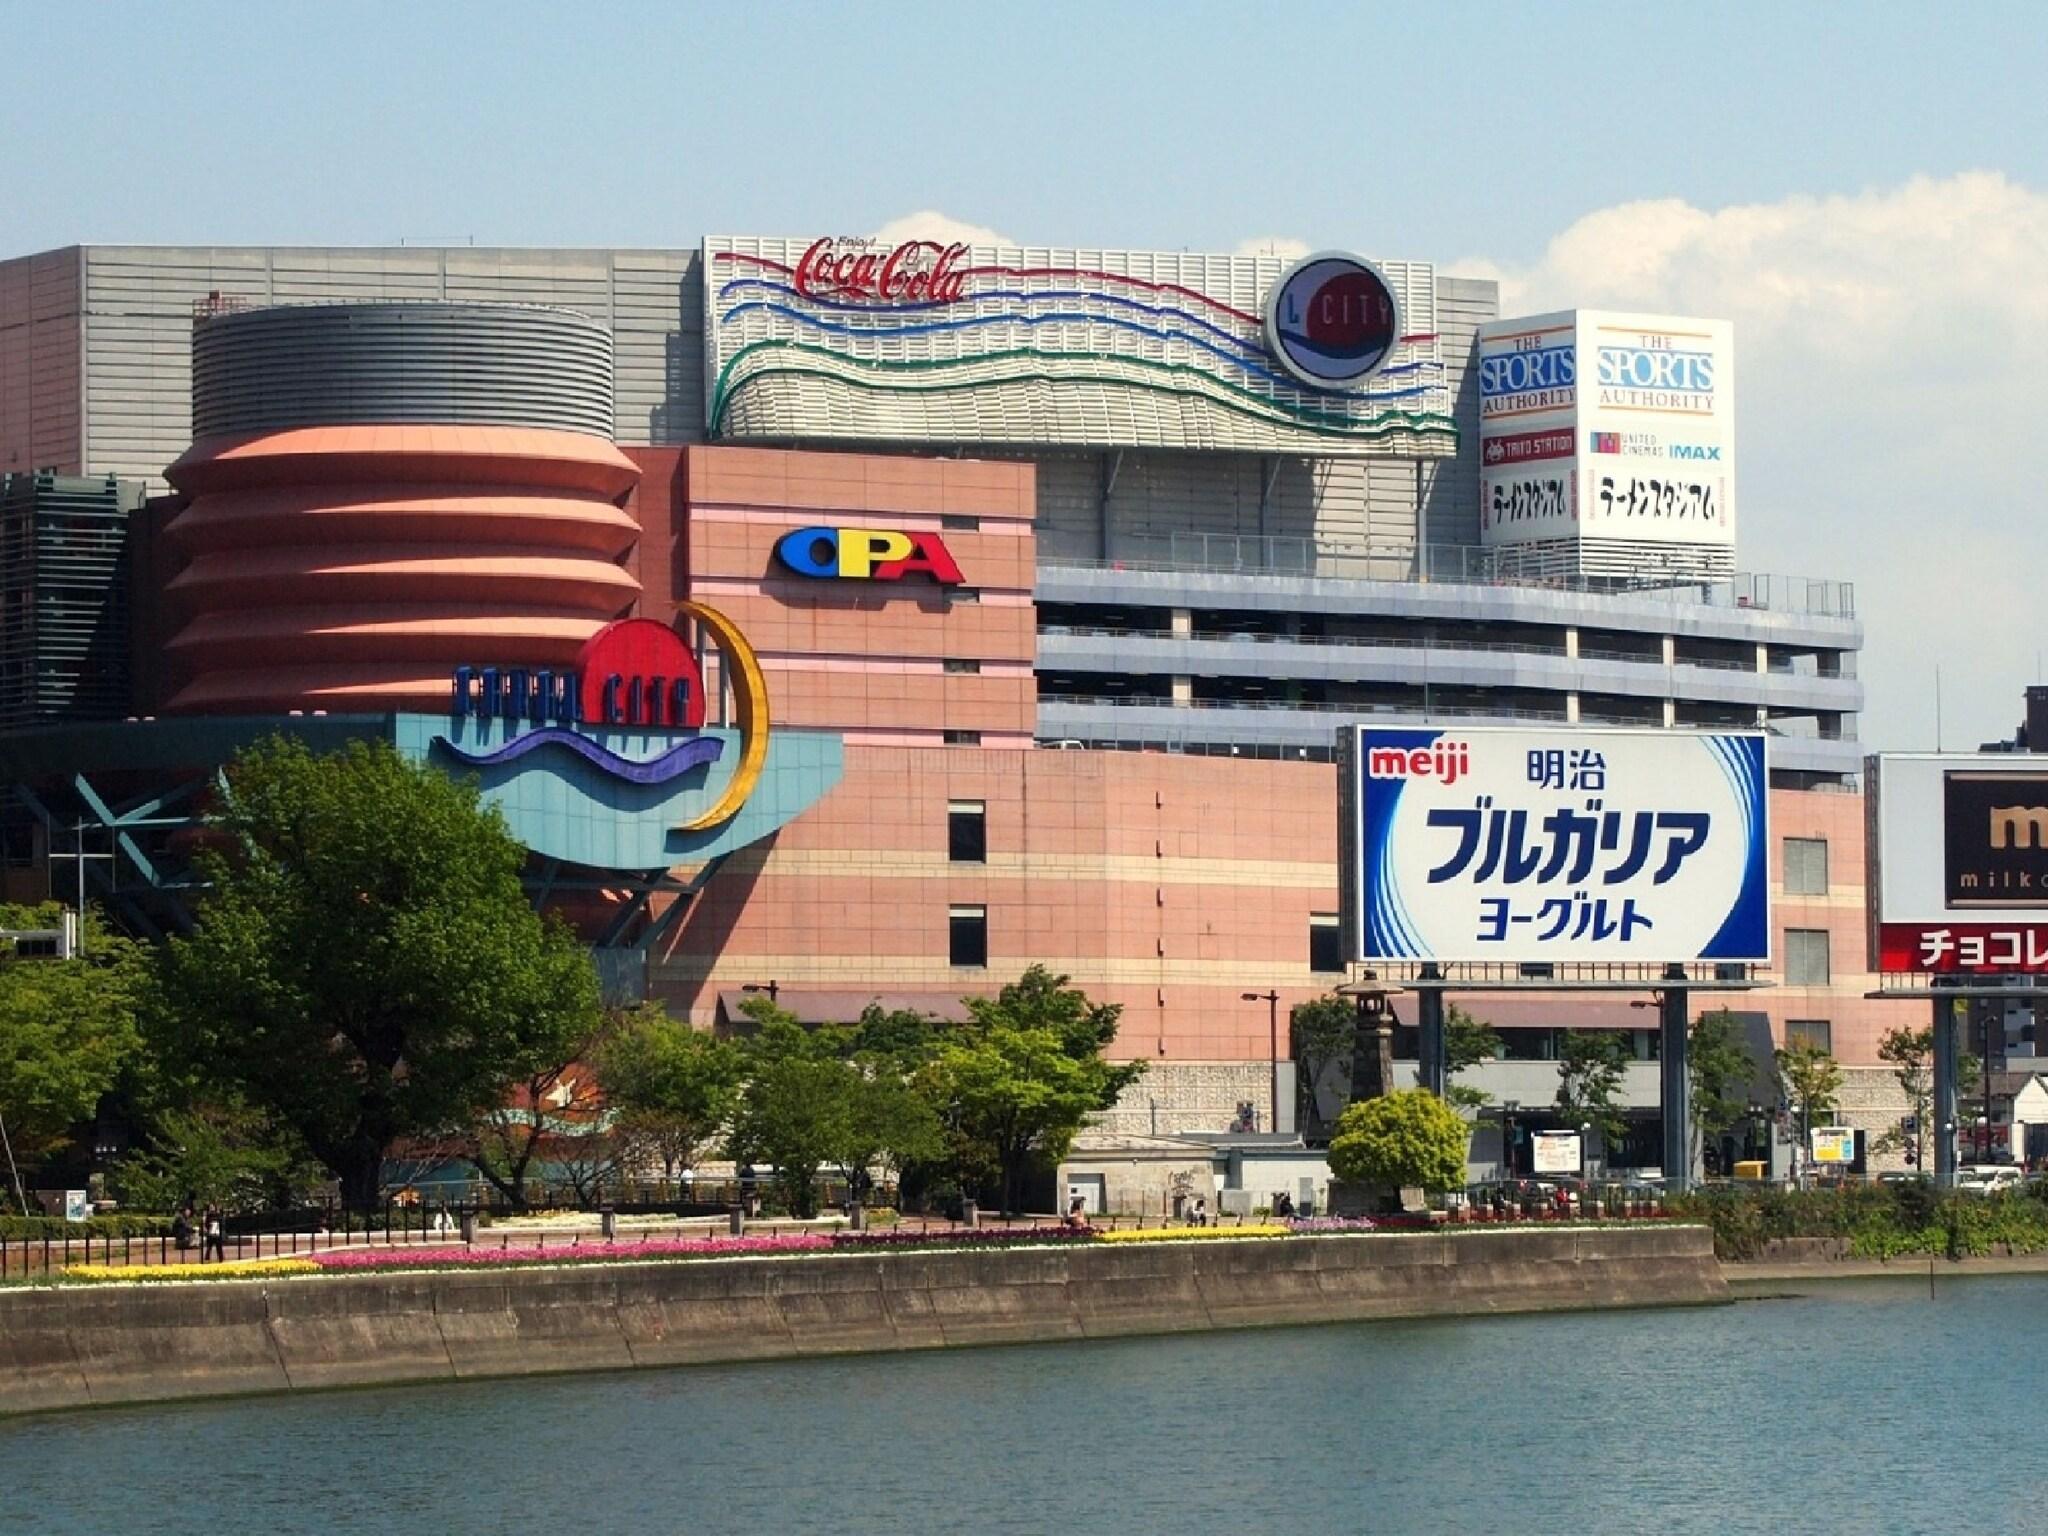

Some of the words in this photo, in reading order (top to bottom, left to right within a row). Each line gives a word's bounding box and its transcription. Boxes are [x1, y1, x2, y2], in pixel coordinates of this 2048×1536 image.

[1322, 294, 1390, 325] CITY
[1513, 335, 1542, 351] THE
[1640, 335, 1672, 349] THE
[1481, 348, 1575, 393] SPORTS
[1598, 349, 1713, 391] SPORTS
[1483, 388, 1576, 413] AUTHORITY
[1599, 389, 1714, 409] AUTHORITY
[1621, 432, 1657, 445] UNITED
[1622, 445, 1664, 457] CINEMAS
[1669, 445, 1720, 460] IMAX
[776, 526, 966, 584] OPA
[605, 673, 690, 724] CITY
[1370, 742, 1470, 784] meiji
[1527, 749, 1607, 790] 明治
[1426, 796, 1711, 886] ブルガリア
[1476, 891, 1653, 942] ヨーグルト
[1920, 929, 2048, 966] チョコレ
